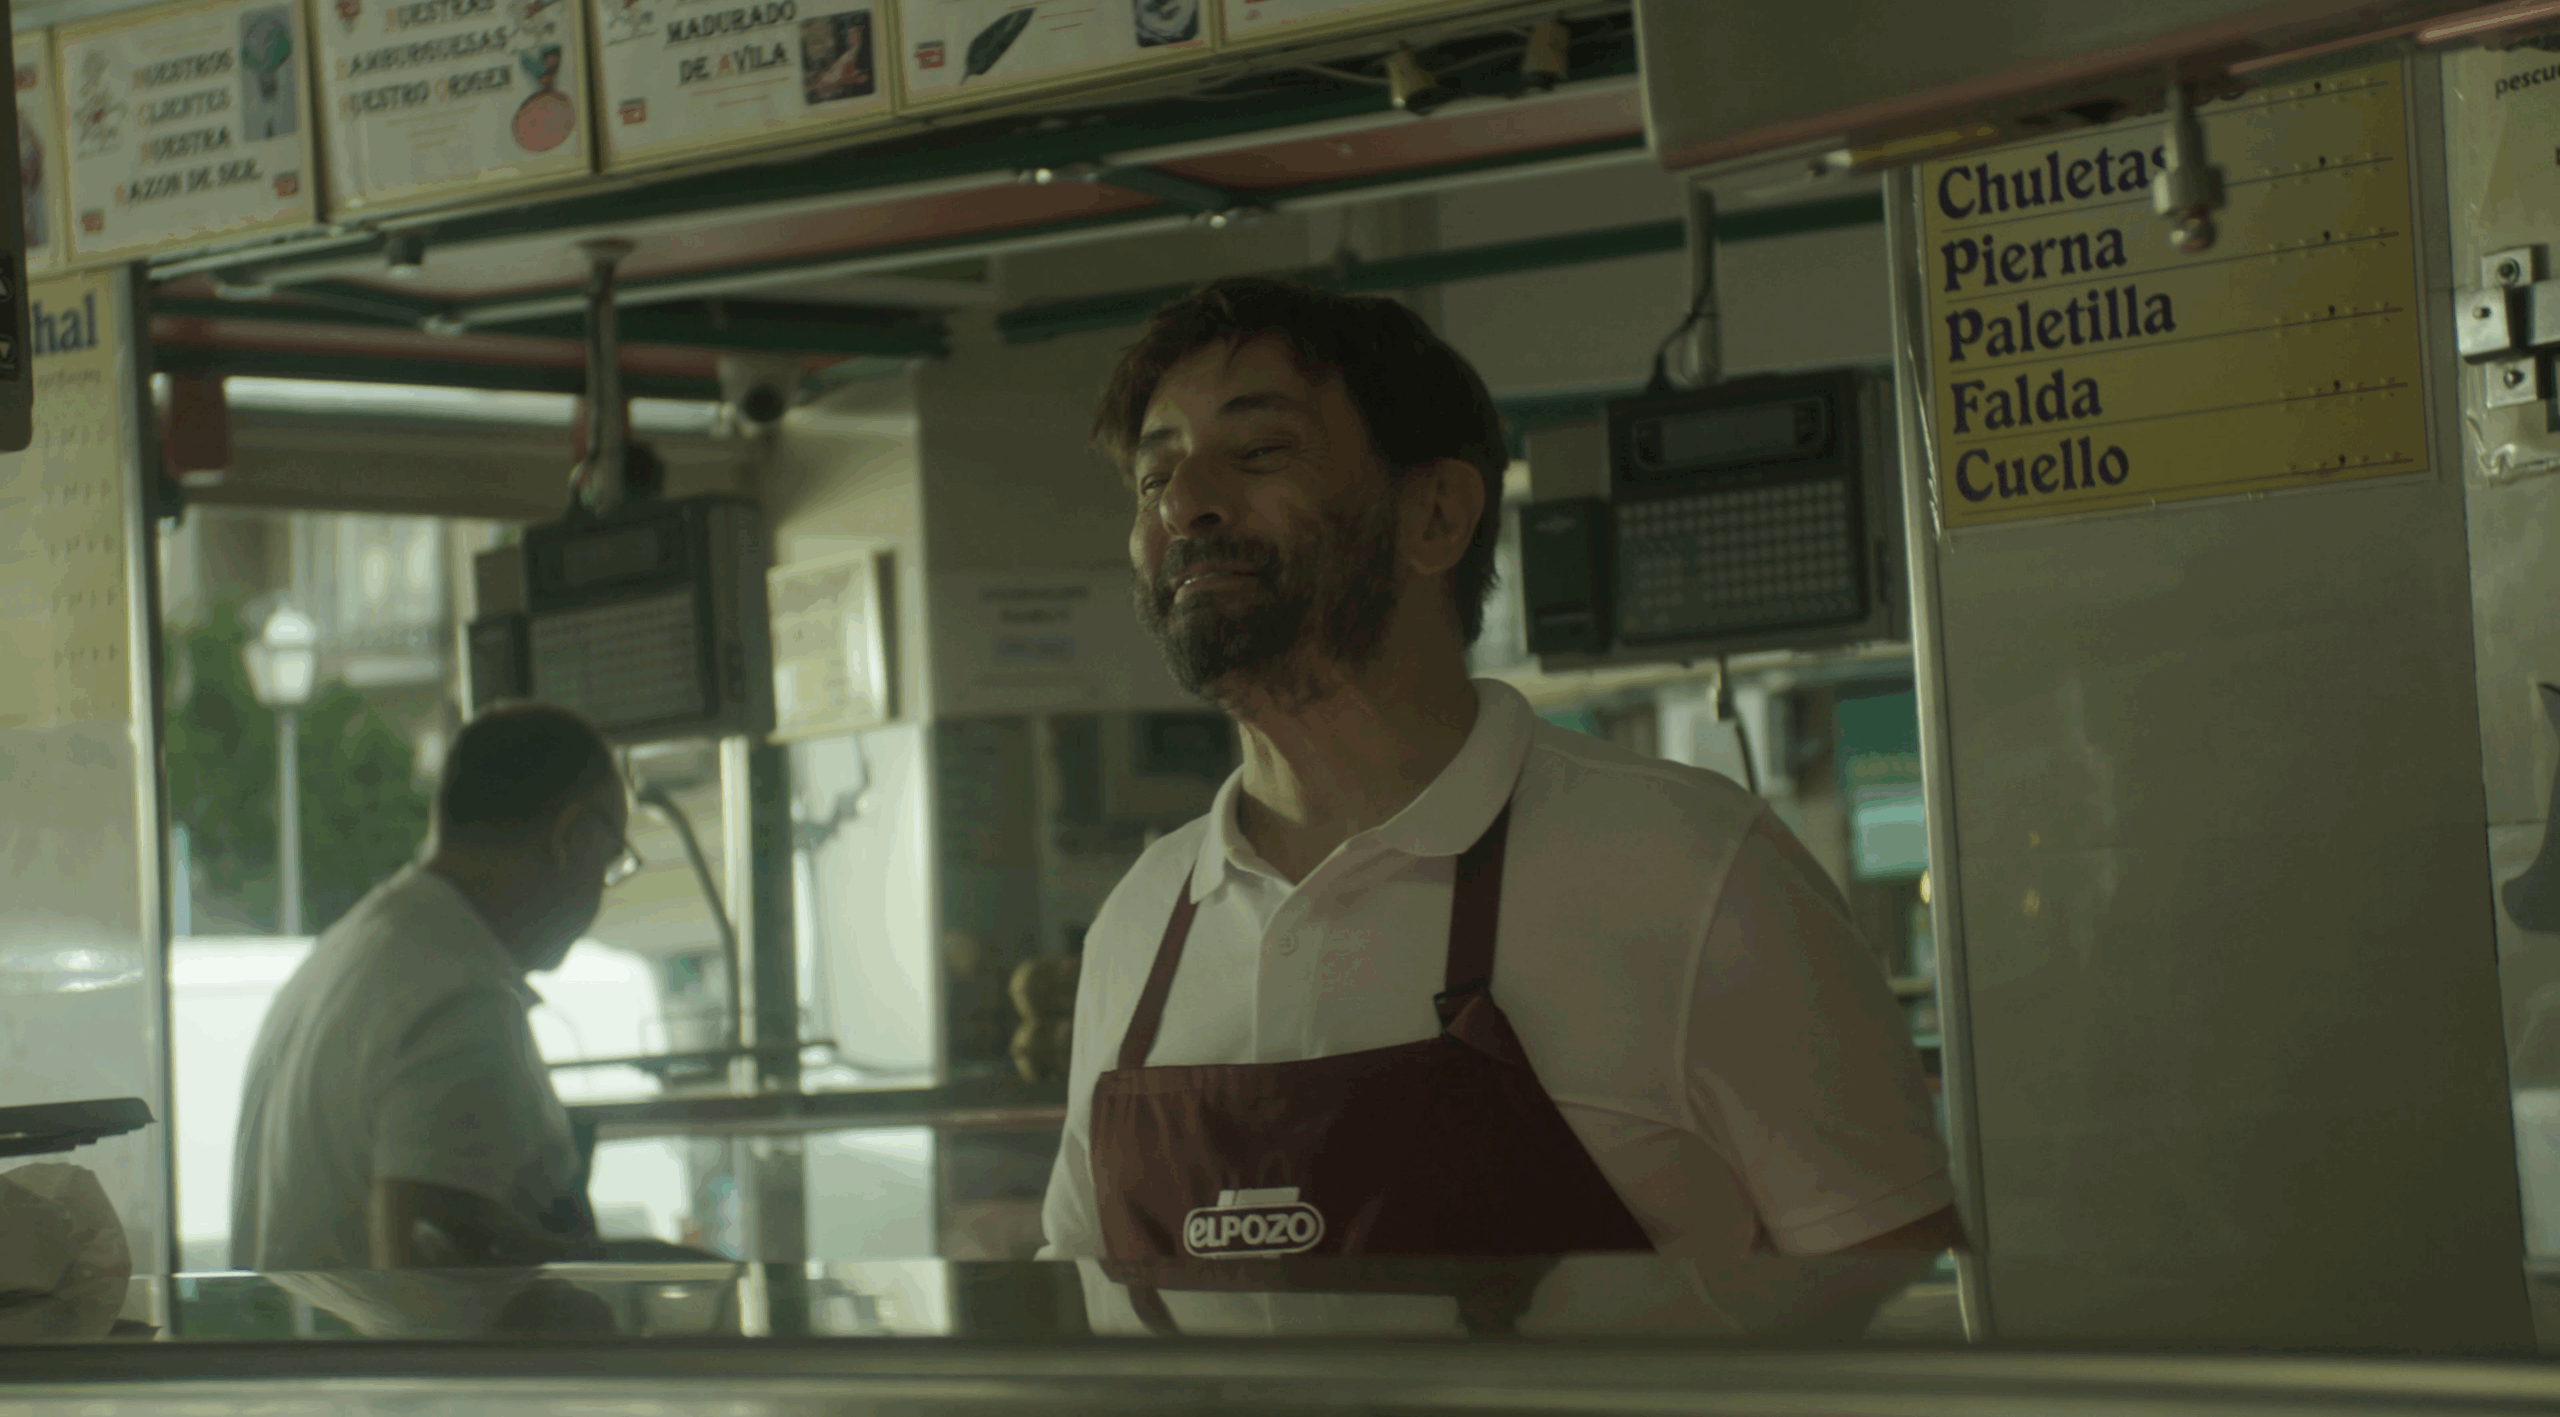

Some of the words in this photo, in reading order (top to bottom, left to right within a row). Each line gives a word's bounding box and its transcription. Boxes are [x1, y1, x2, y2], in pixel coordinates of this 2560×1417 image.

[666, 0, 797, 43] MADURADO
[679, 55, 712, 85] DE
[1940, 226, 2128, 293] Pierna
[1945, 284, 2177, 363] Paletilla
[1949, 368, 2104, 435] Falda
[1956, 436, 2130, 502] Cuello
